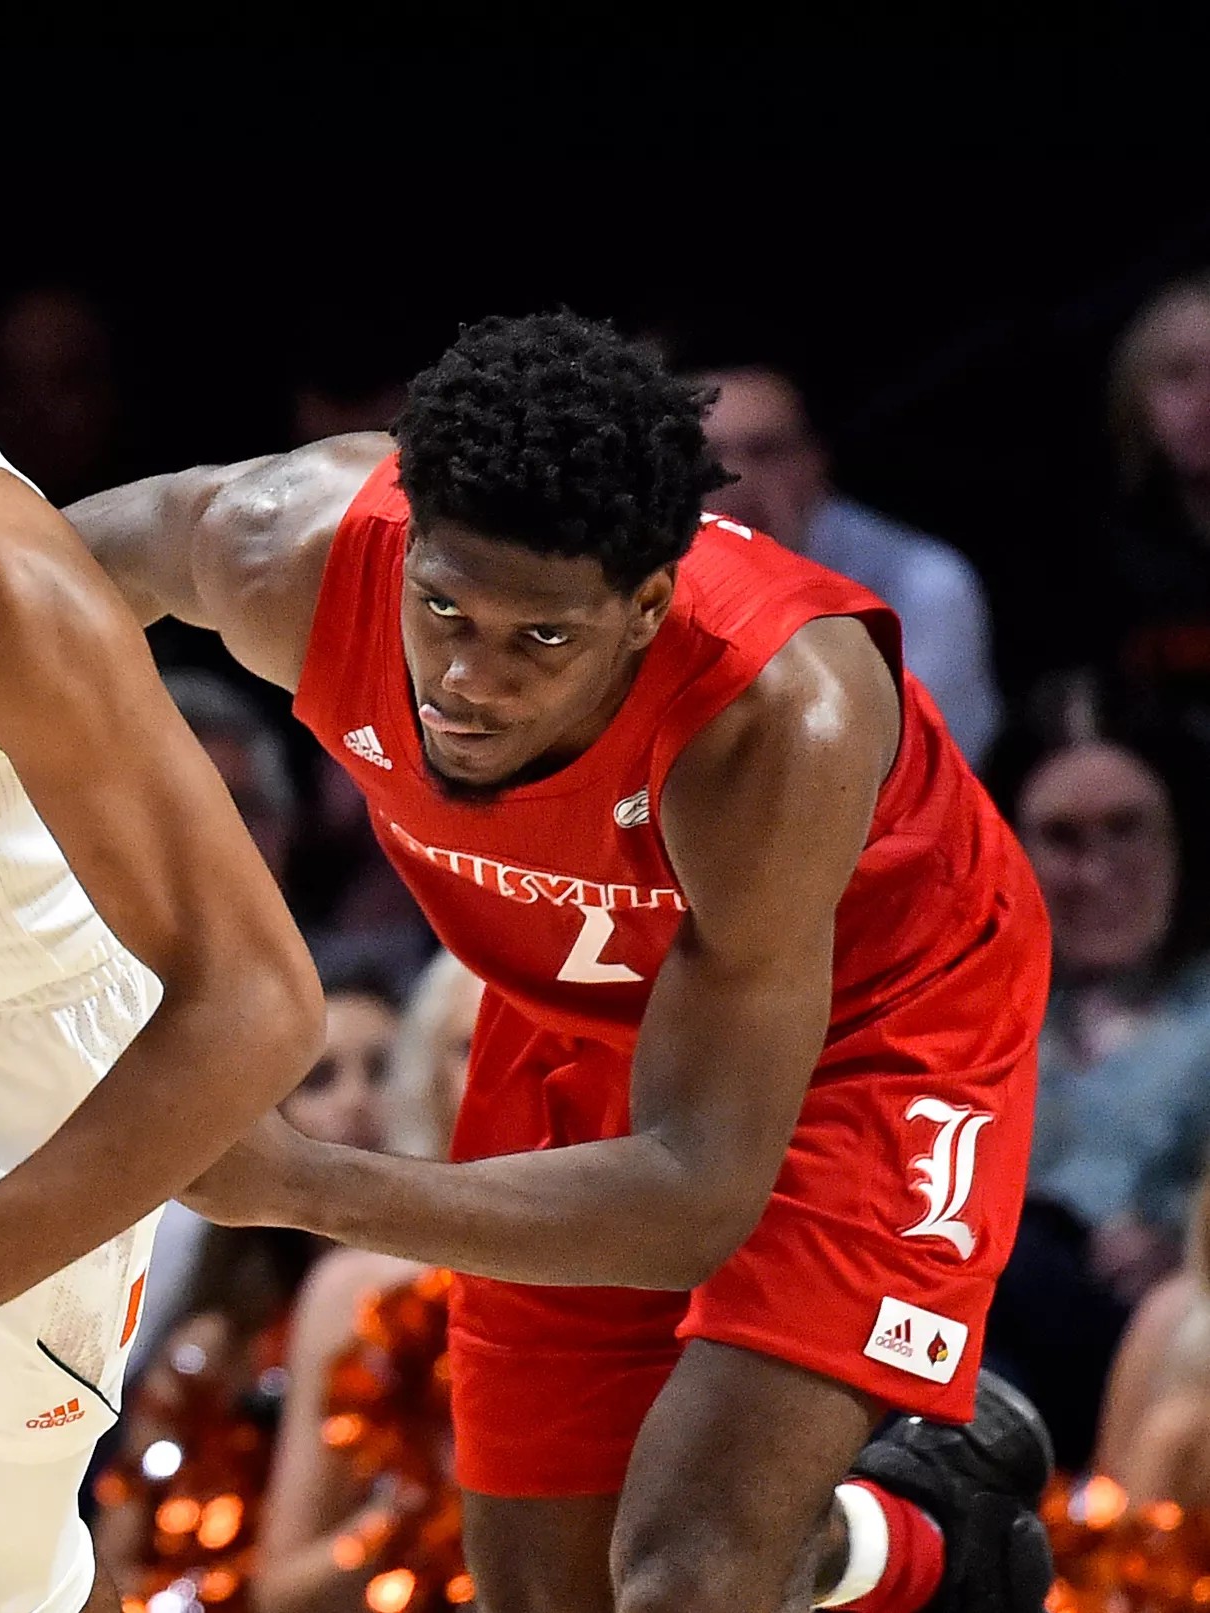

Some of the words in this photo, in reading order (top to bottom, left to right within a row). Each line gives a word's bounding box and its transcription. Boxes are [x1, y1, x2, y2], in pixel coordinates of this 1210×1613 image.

[343, 733, 393, 771] adidas
[896, 1095, 995, 1260] L
[875, 1335, 914, 1358] adidas
[25, 1410, 86, 1430] adidas
